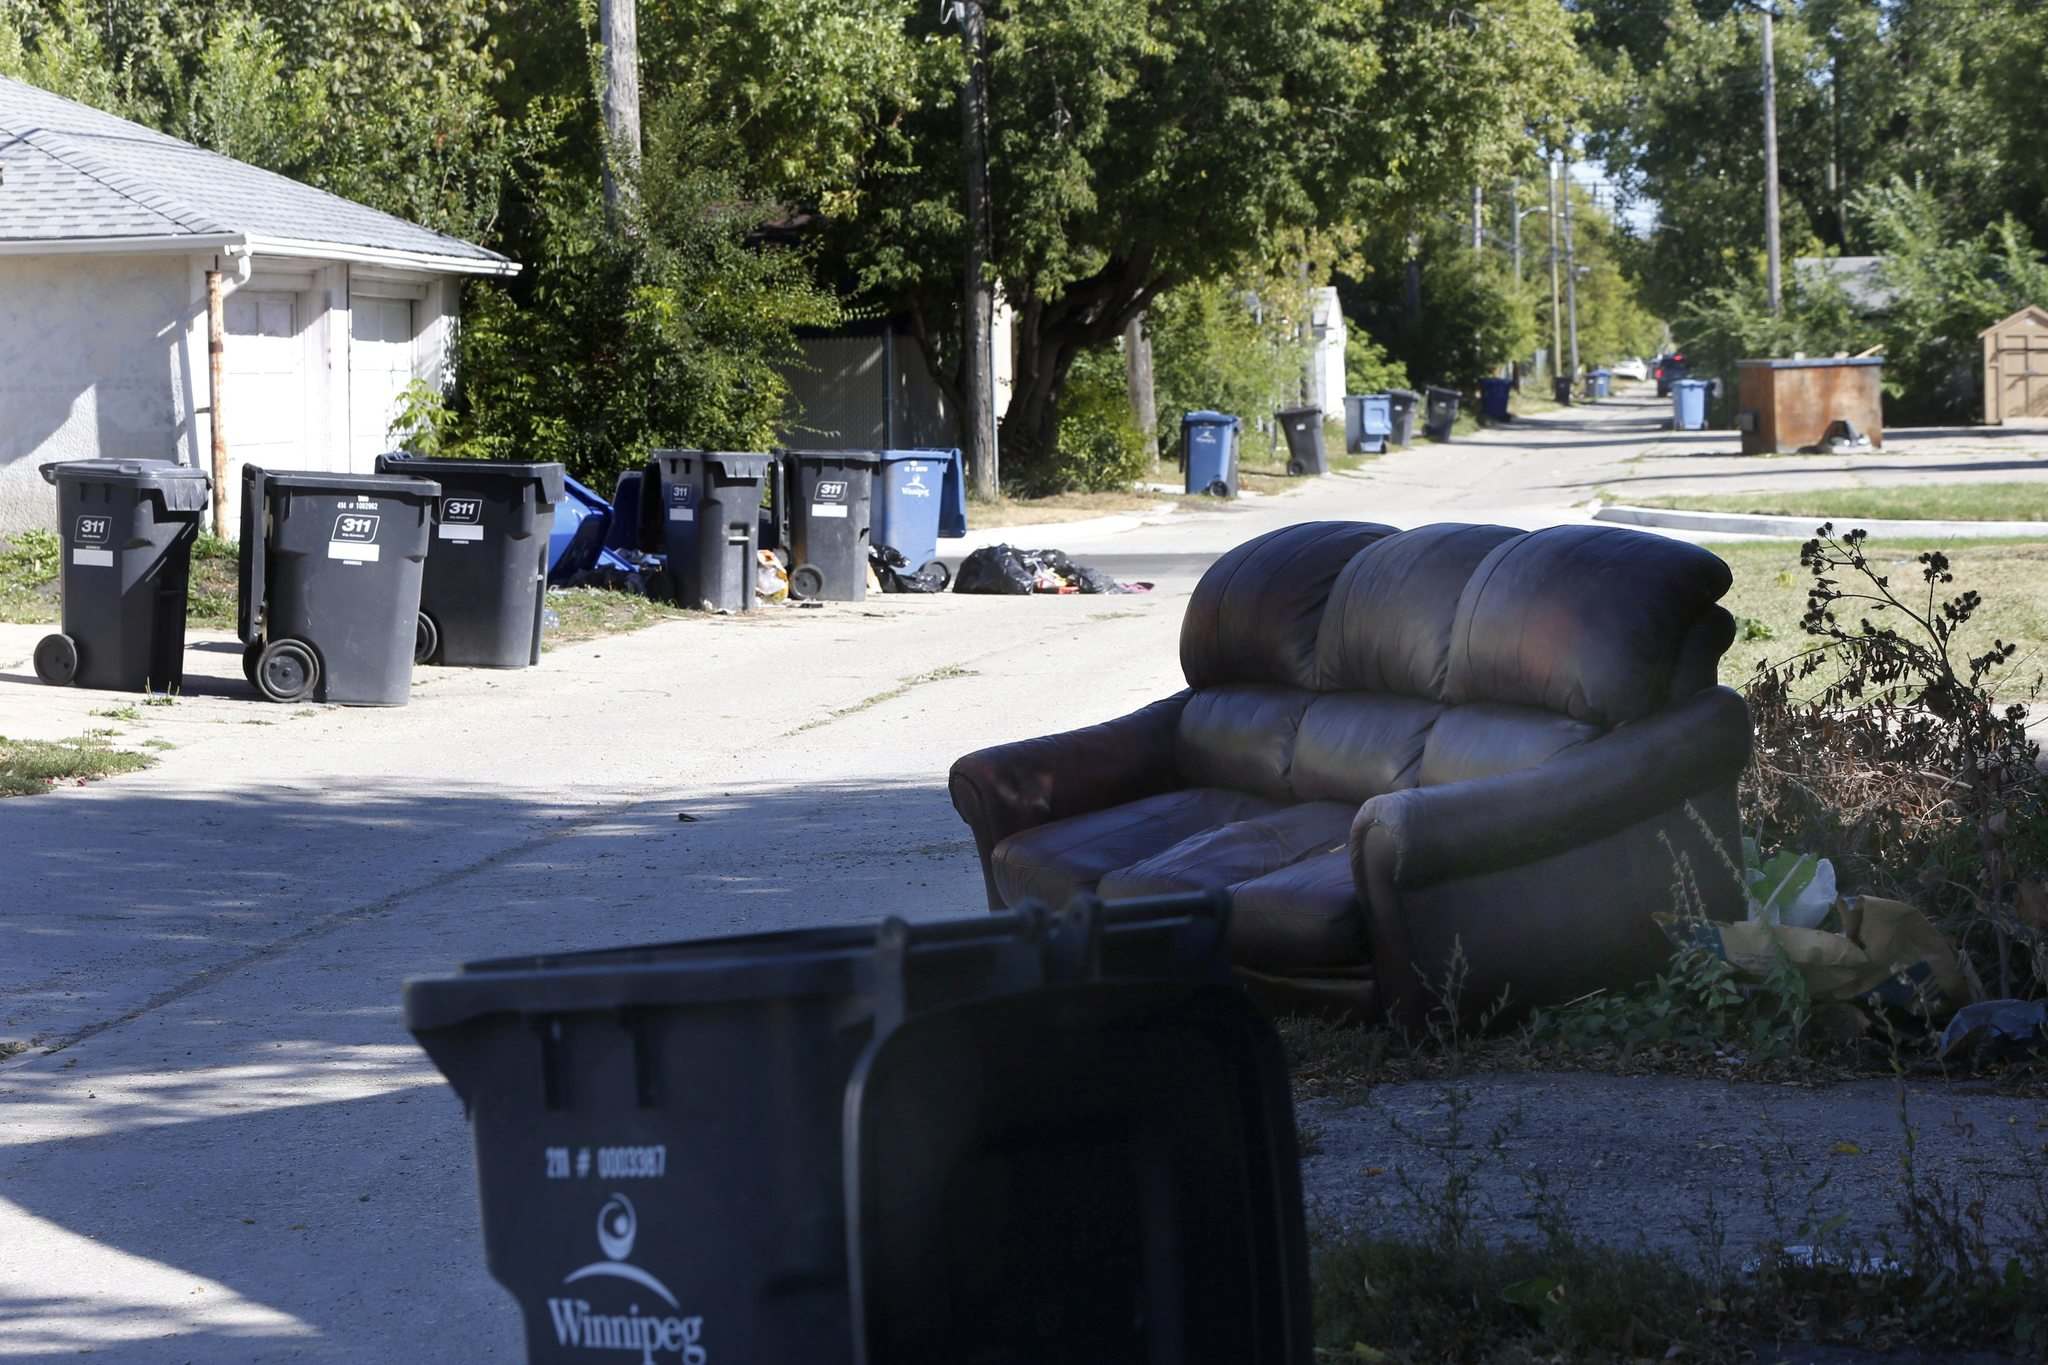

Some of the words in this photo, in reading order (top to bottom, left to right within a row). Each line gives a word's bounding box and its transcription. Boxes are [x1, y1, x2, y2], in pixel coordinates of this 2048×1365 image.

[673, 486, 687, 497] 311
[820, 484, 841, 495] 311
[449, 502, 475, 514] 311
[81, 519, 105, 533] 311
[341, 518, 371, 533] 311
[547, 1298, 707, 1365] Winnipeg
